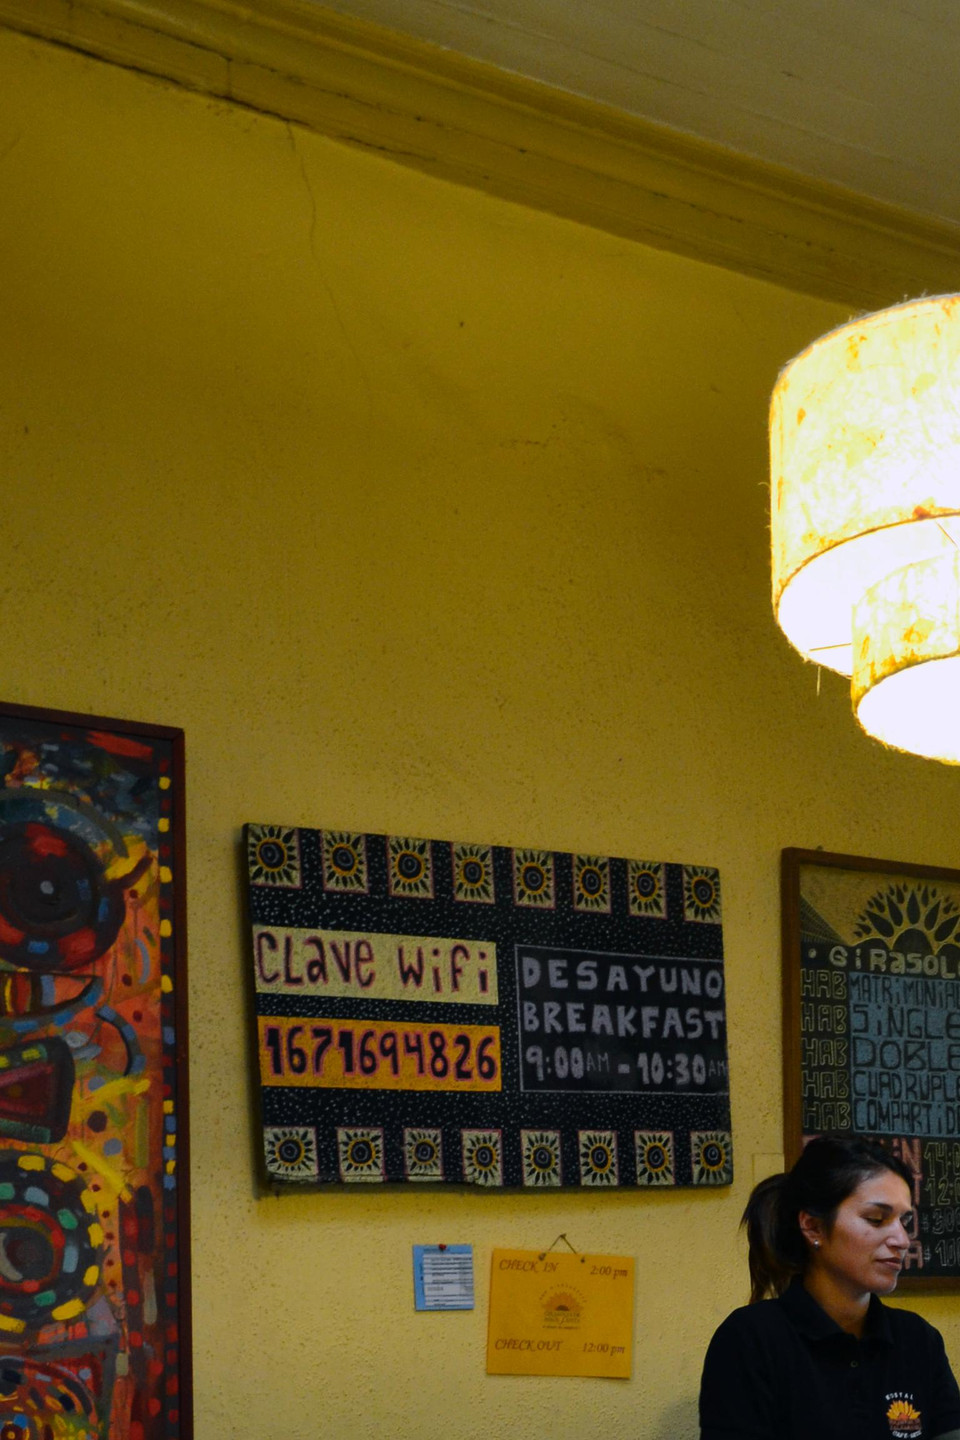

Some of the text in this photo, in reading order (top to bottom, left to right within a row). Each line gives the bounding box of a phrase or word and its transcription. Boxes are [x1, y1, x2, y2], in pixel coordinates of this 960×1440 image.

[521, 956, 723, 999] DESAYUNO
[800, 968, 847, 999] HAB
[523, 1001, 724, 1040] BREAKFAST
[801, 1002, 847, 1034] HAB
[265, 1025, 499, 1082] 1671694826
[801, 1037, 848, 1067] HAB
[803, 1070, 849, 1099] HAB
[804, 1099, 851, 1131] HAB
[499, 1258, 540, 1274] CHECK
[543, 1261, 560, 1273] IN
[590, 1264, 612, 1276] 2:00
[494, 1338, 536, 1352] CHECK
[537, 1340, 564, 1352] OUT
